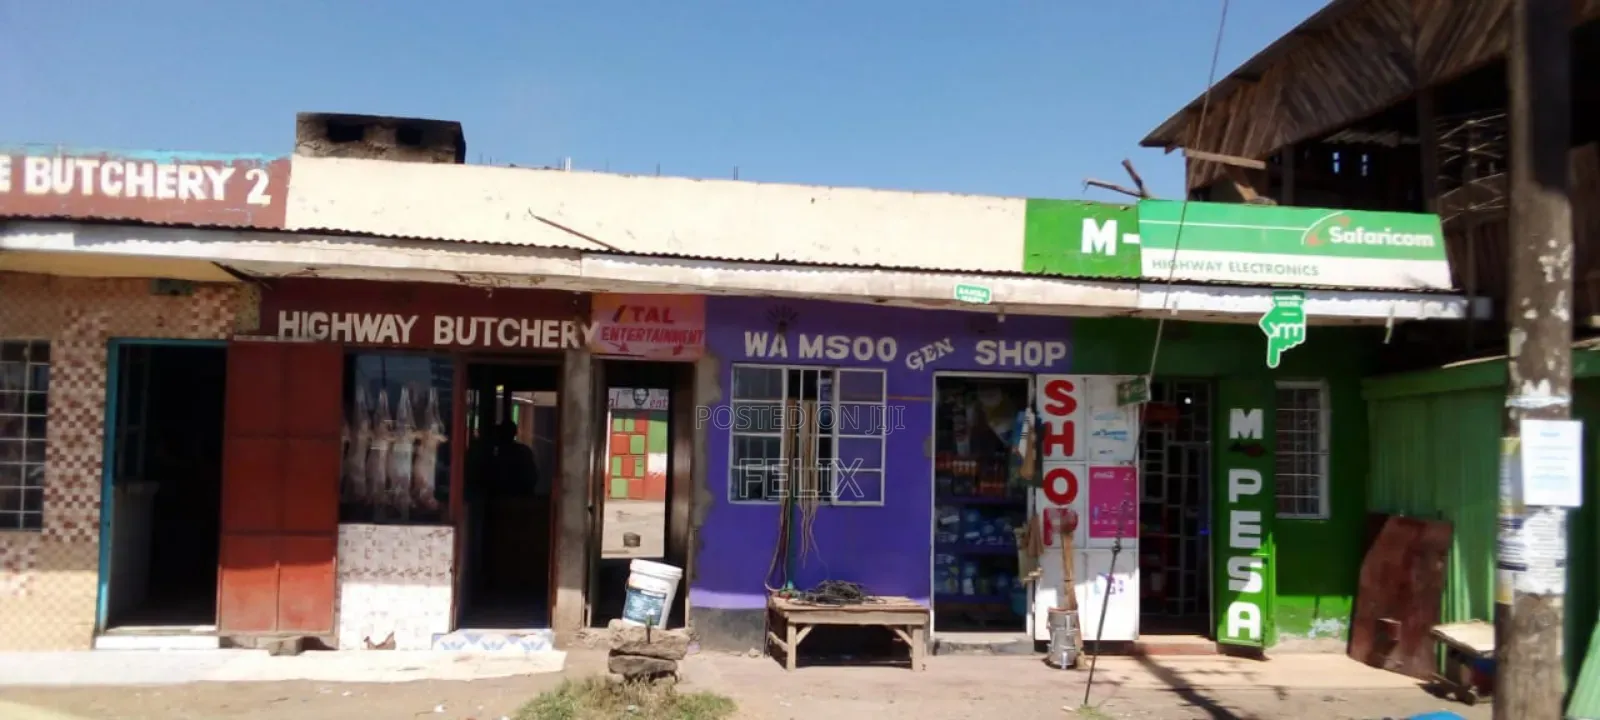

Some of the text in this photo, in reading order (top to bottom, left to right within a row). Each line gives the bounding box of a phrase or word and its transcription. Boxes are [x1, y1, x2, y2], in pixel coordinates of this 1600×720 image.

[24, 155, 236, 201] BUTCHERY
[246, 168, 272, 206] 2
[1328, 226, 1435, 247] Safaricom
[1152, 258, 1320, 277] HIGHWAY ELECTRONICS
[277, 310, 599, 350] HIGHWAY BUTCHERY
[799, 334, 897, 362] MSOO
[905, 338, 955, 372] GEN
[974, 340, 1067, 367] SHOP
